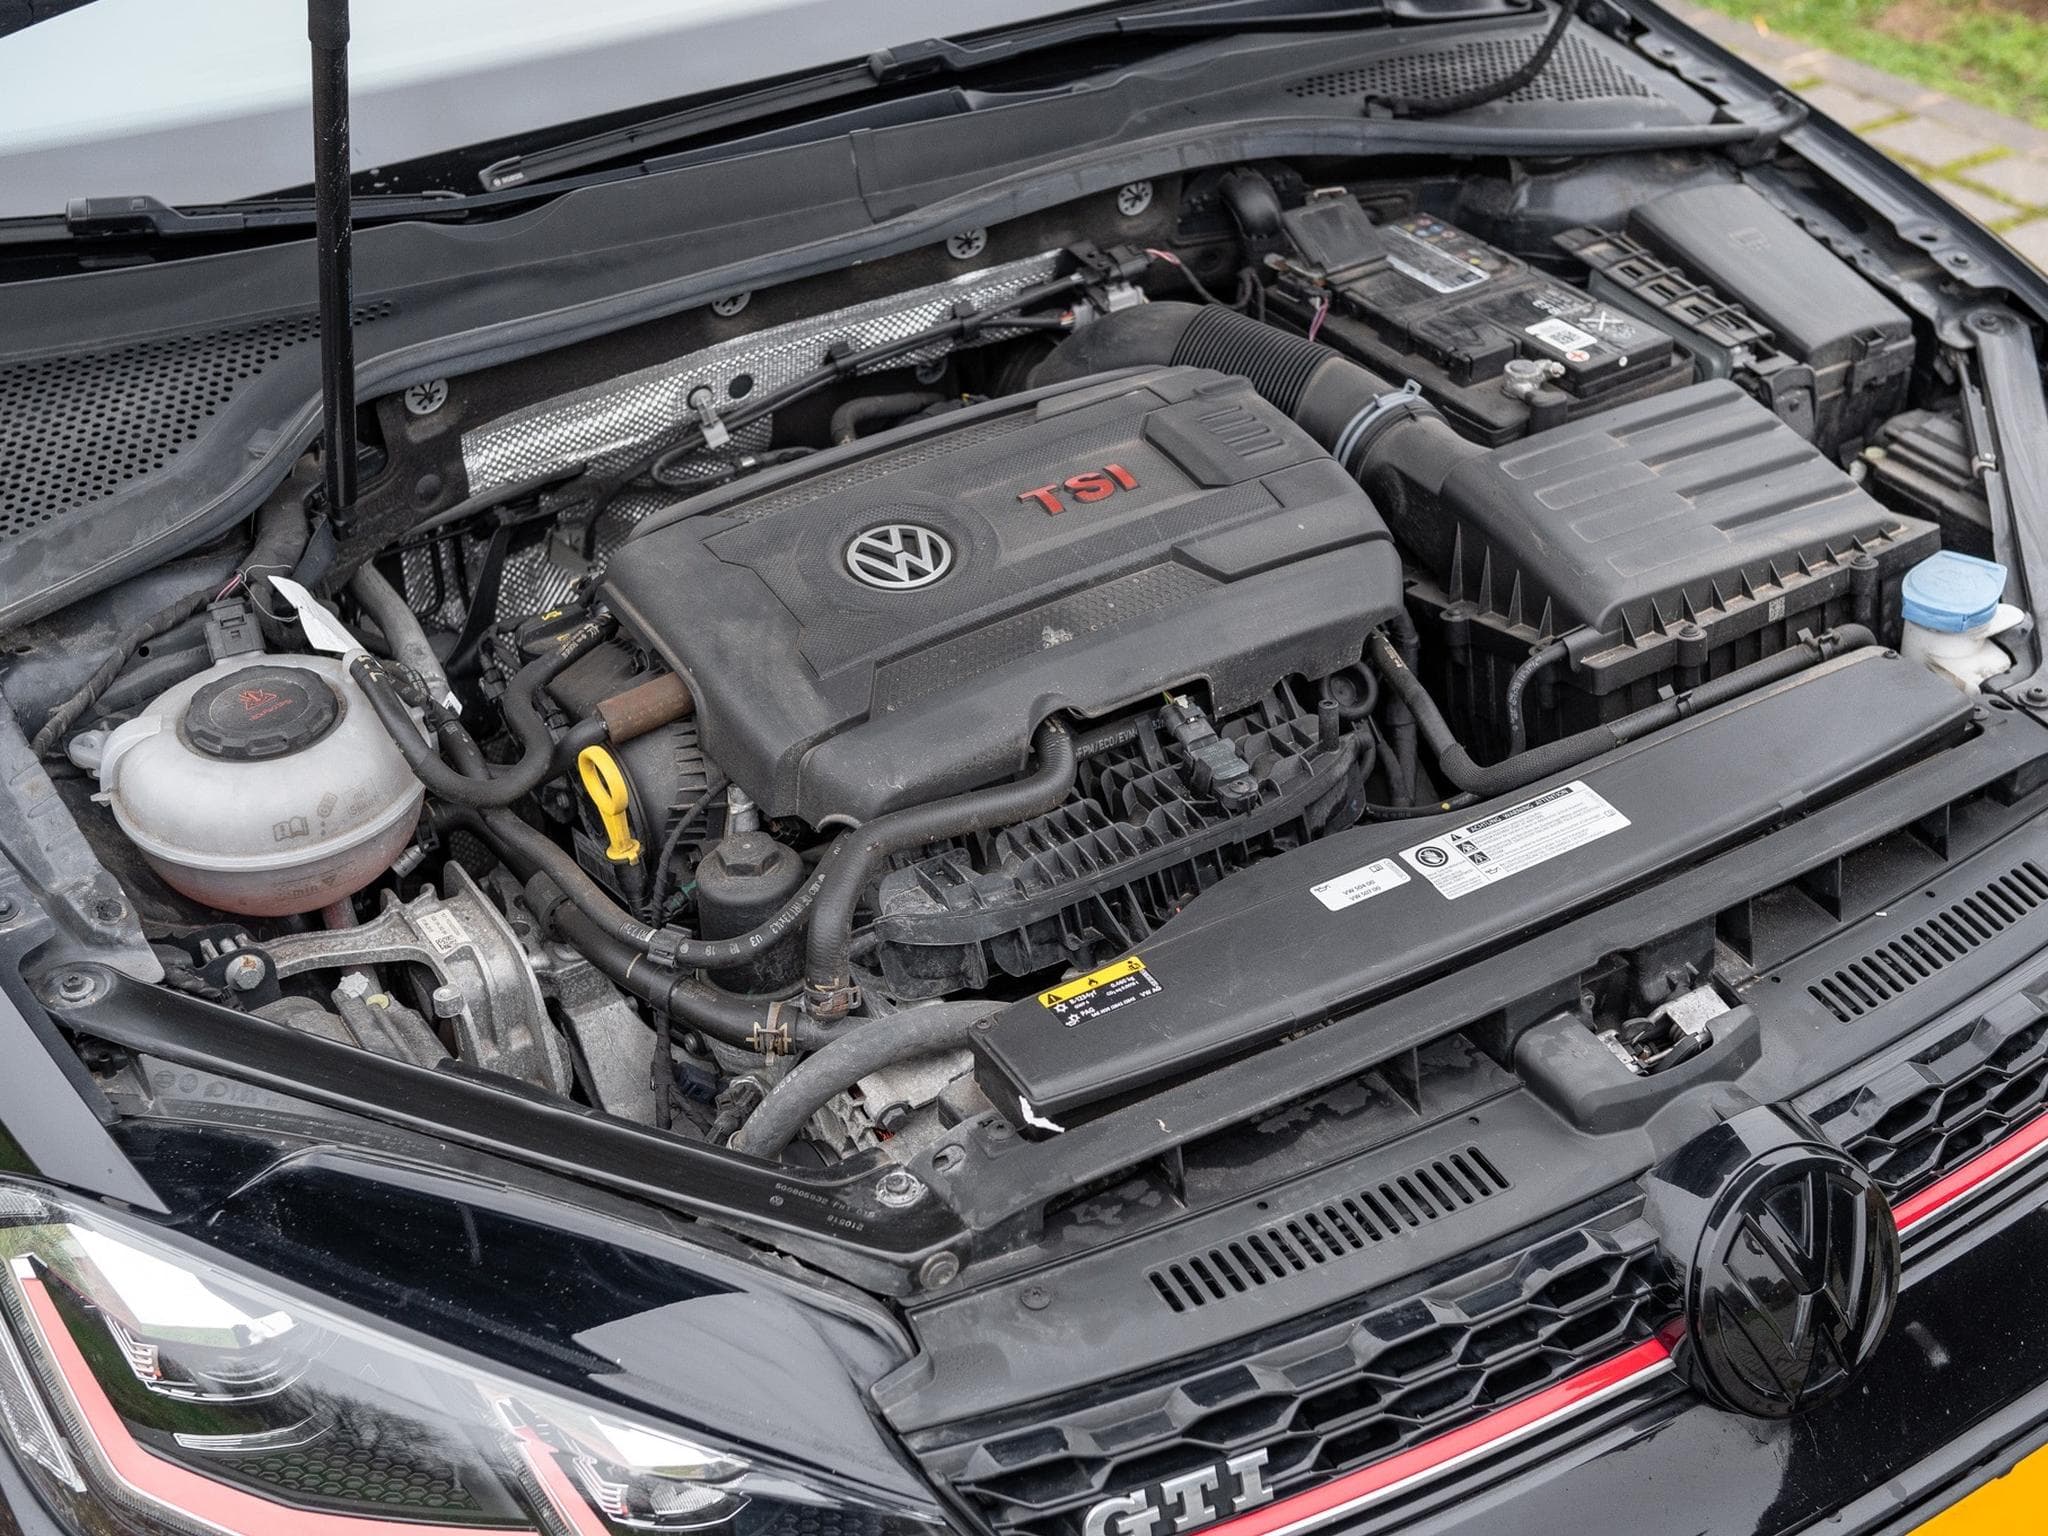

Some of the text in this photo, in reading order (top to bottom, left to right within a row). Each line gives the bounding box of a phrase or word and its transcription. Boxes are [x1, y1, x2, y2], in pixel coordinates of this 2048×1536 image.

[1017, 463, 1140, 517] TSI
[1471, 789, 1568, 833] ACHTUNG WARNING ATTENTION
[1082, 1447, 1274, 1536] GTI
